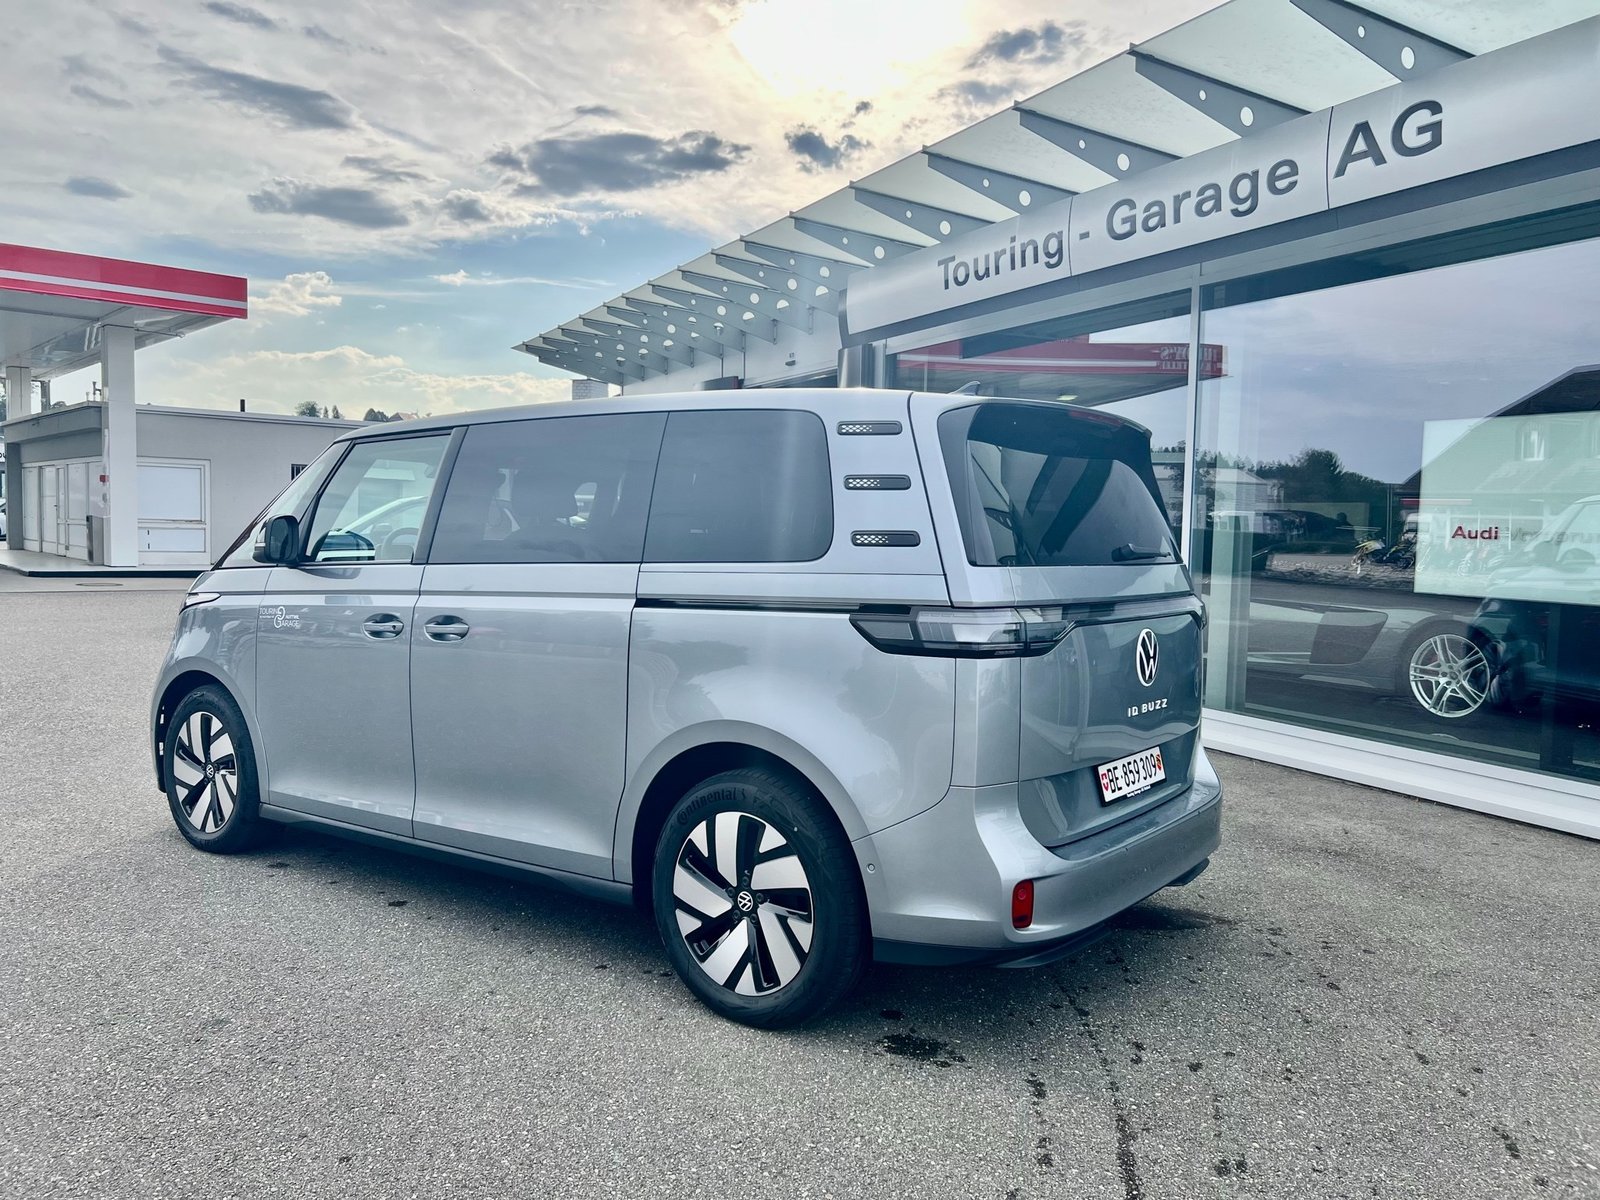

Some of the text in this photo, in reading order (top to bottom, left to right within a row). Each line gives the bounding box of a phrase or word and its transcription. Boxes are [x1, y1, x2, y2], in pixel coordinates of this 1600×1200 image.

[937, 228, 1064, 290] Touring
[1106, 158, 1299, 241] Garage
[1333, 99, 1443, 179] AG
[1452, 525, 1499, 540] Audi
[1141, 698, 1168, 714] BUZZ
